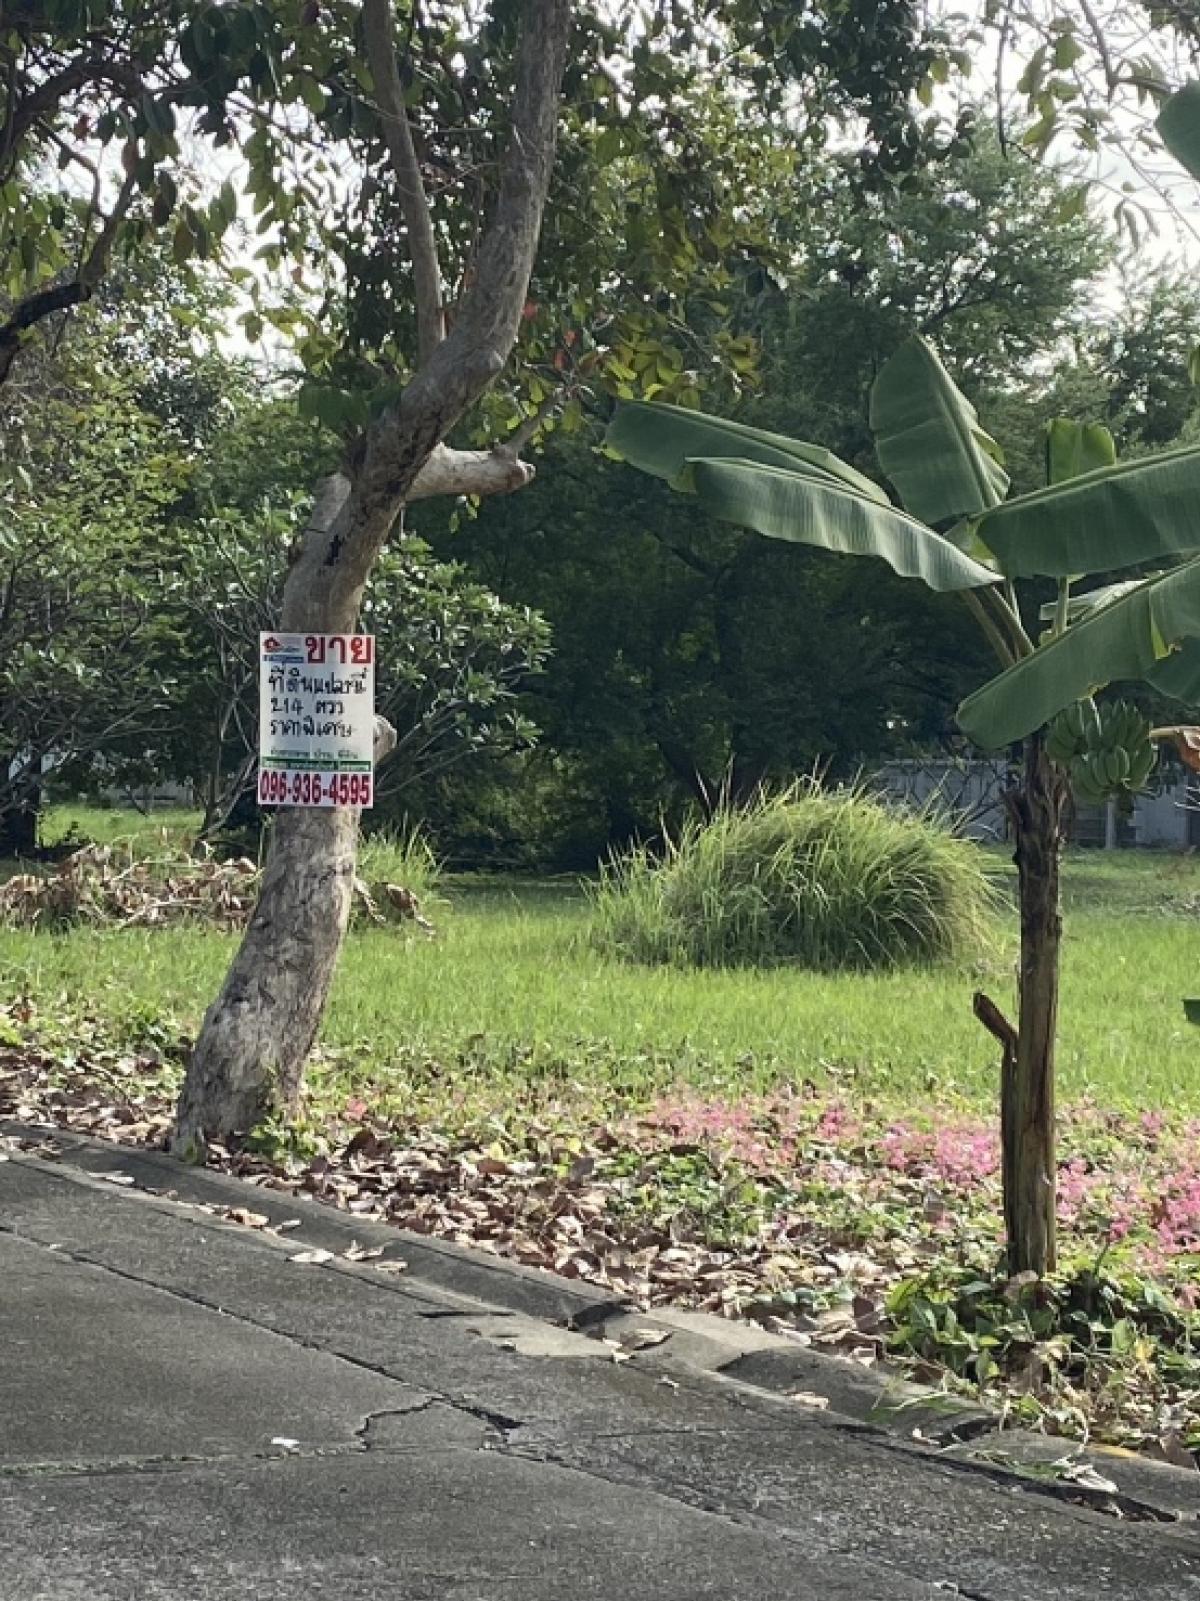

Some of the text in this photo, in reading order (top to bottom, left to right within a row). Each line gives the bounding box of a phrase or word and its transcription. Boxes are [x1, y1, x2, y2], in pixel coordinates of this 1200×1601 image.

[305, 637, 371, 663] ขาย
[271, 698, 304, 715] 214
[260, 770, 370, 804] 096-936-4595
